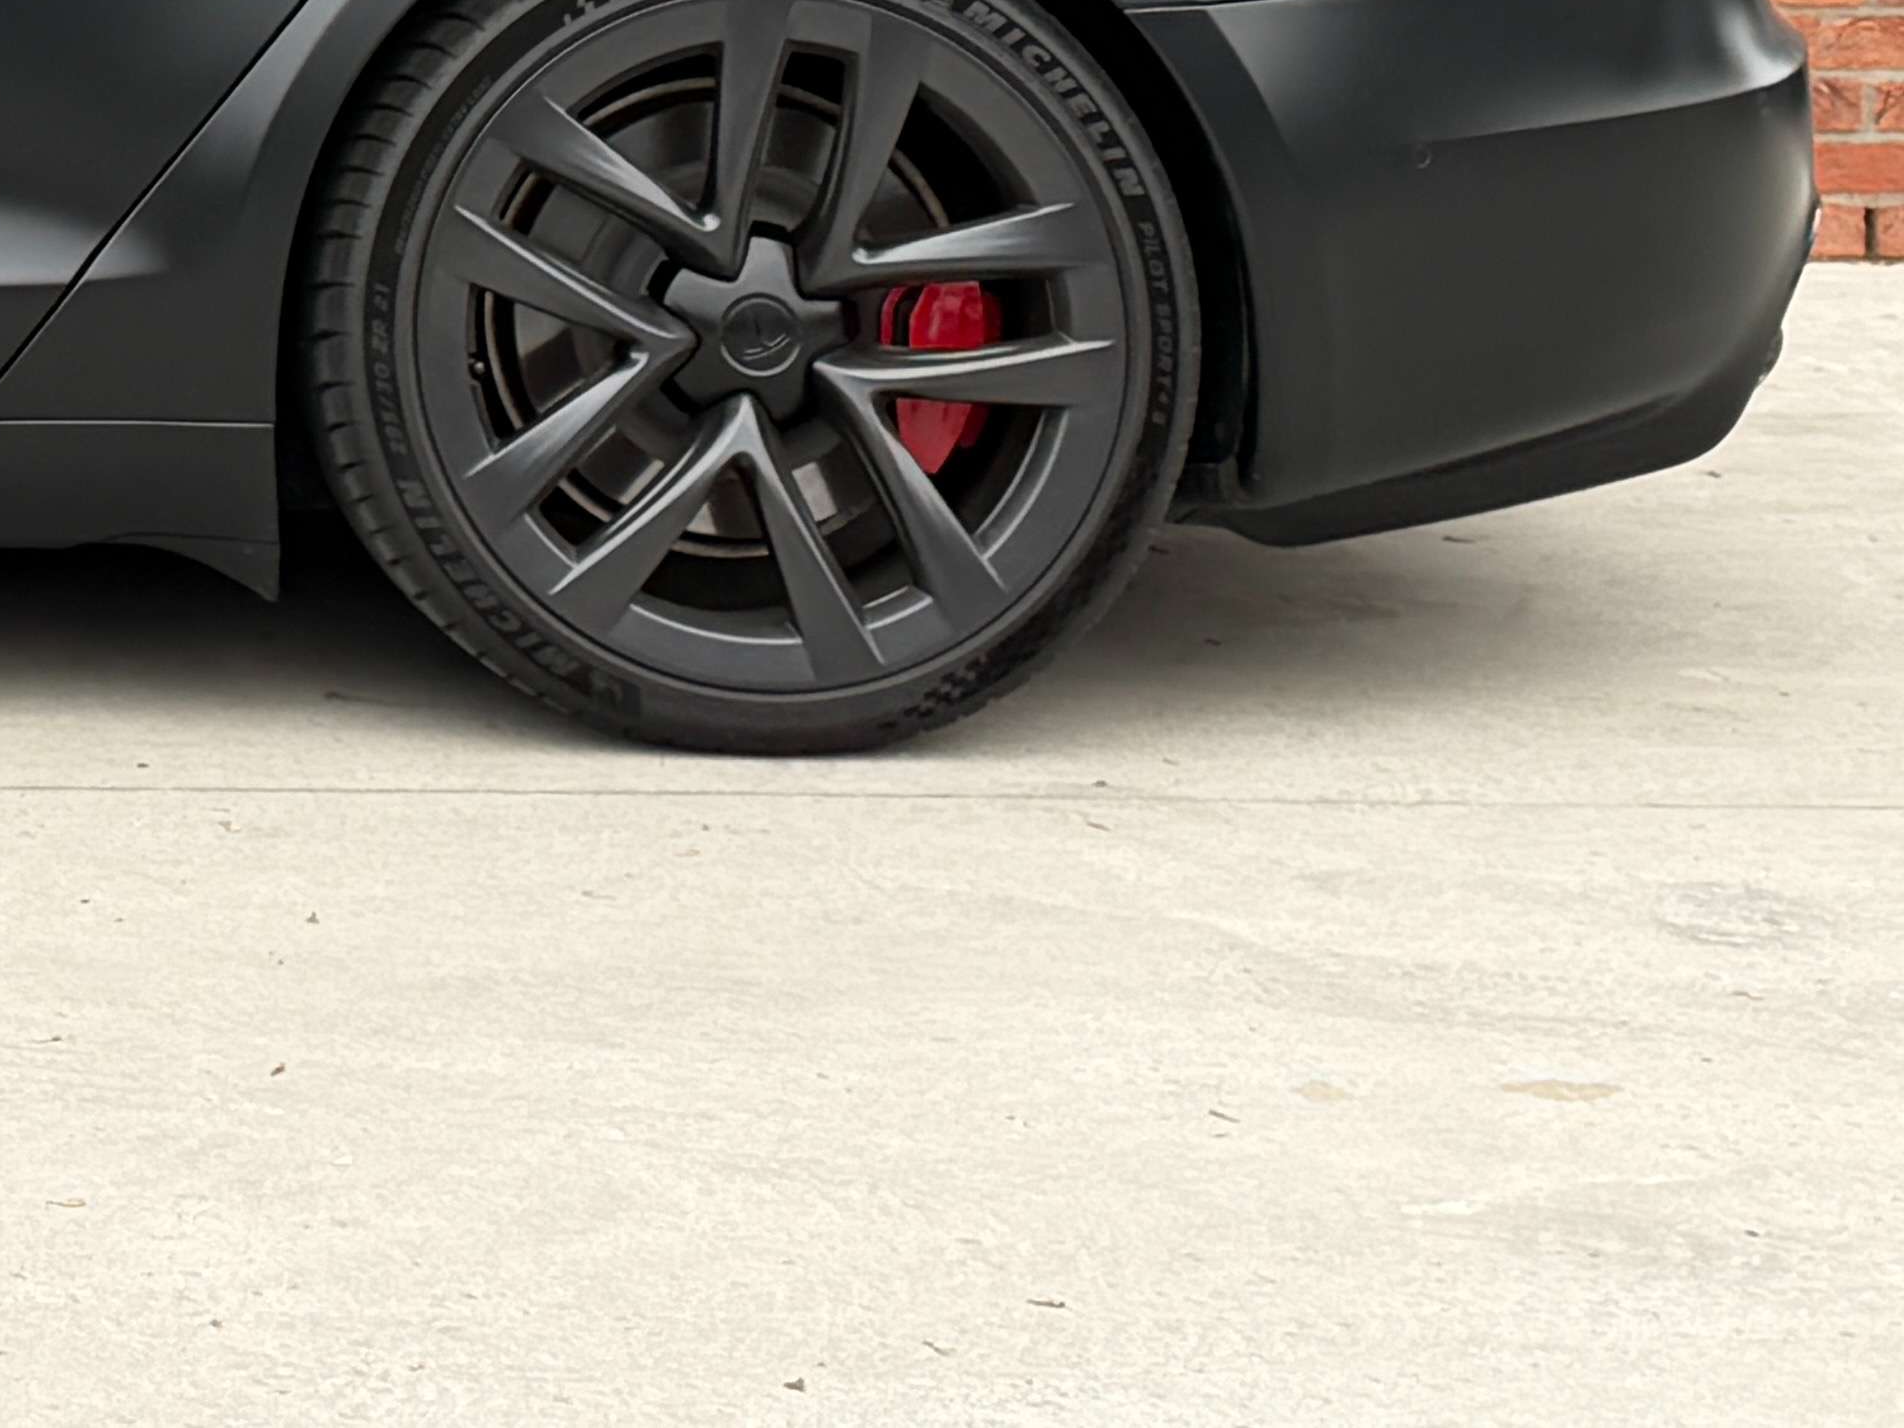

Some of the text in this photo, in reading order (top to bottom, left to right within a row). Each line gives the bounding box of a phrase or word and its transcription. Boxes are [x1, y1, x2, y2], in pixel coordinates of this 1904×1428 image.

[962, 0, 1146, 197] MICHELIN
[1137, 221, 1169, 295] PILOT
[1155, 303, 1174, 390] SPORT
[396, 480, 580, 677] MICHELIN
